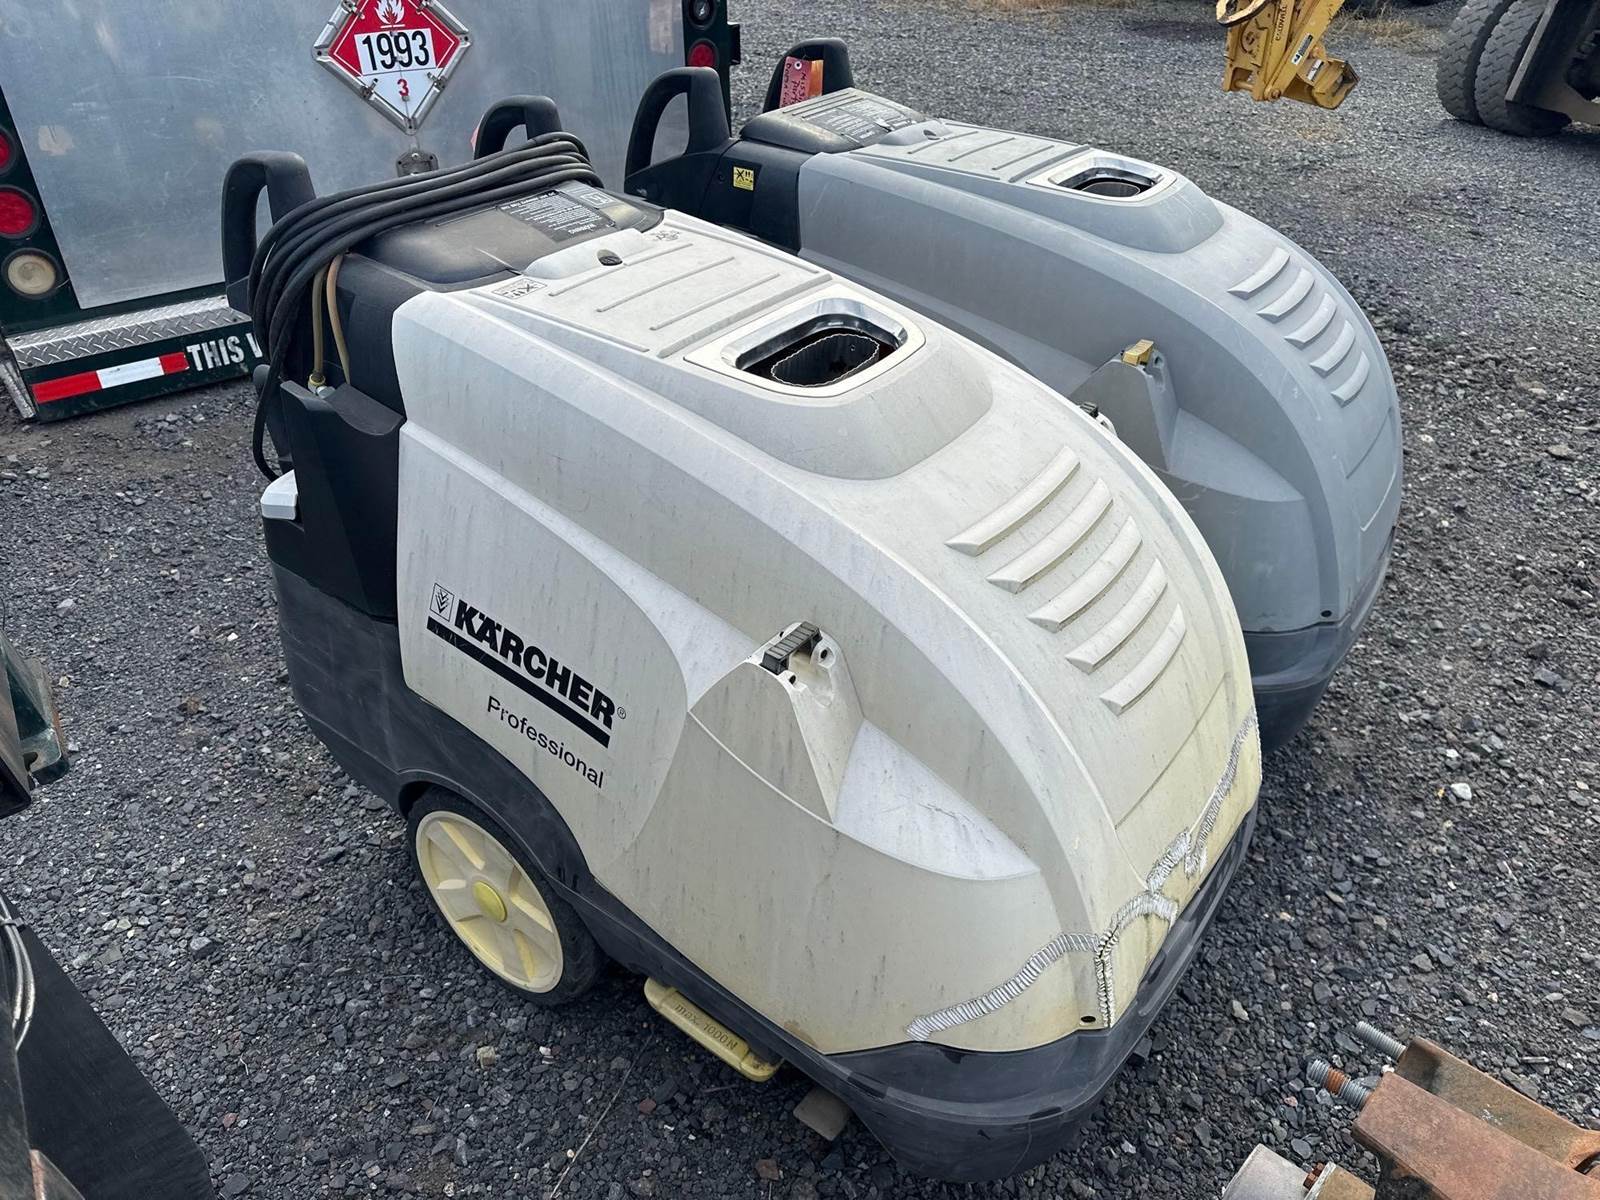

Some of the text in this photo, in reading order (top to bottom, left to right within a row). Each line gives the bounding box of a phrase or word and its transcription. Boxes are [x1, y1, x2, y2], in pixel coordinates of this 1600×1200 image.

[362, 30, 430, 71] 1993
[397, 79, 409, 97] 3
[186, 335, 244, 371] THIS
[487, 695, 604, 789] Professional
